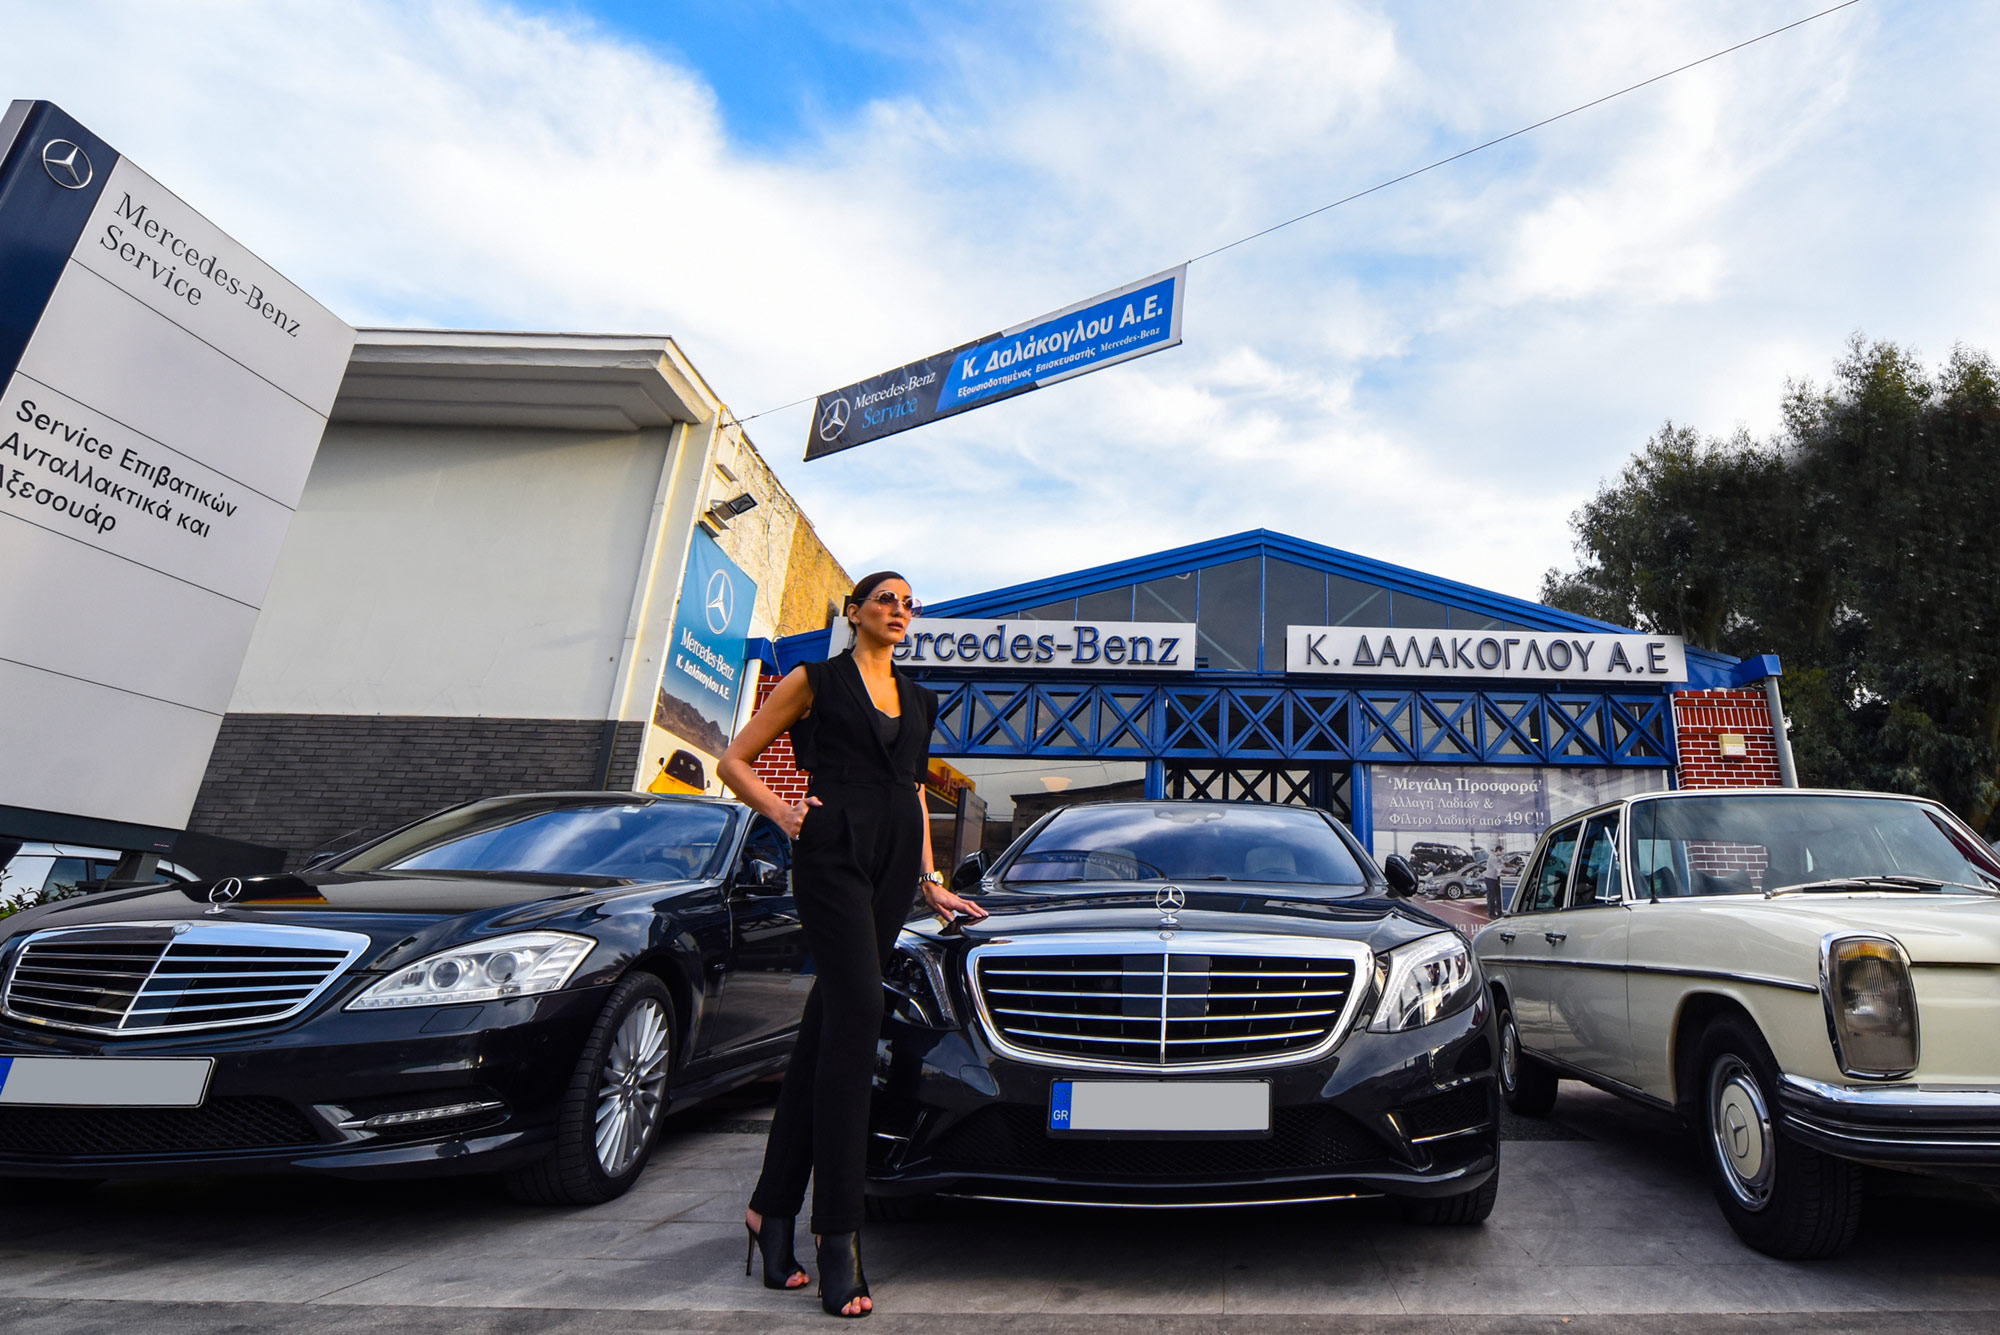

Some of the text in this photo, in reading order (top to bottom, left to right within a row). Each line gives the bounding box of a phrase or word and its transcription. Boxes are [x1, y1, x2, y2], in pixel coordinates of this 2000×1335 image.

[99, 224, 202, 306] Service
[113, 191, 301, 338] Mercedes-Benz
[961, 294, 1164, 380] Κ. Δαλάκογλου Α.Ε.
[957, 326, 1161, 397] Εξουσιοδοτημένος Επισκευαστής Mercedes-Benz
[854, 369, 937, 411] Mercedes-Benz
[861, 395, 919, 430] Service
[15, 399, 239, 519] Service Επιβατικών
[0, 431, 211, 538] Ανταλλακτικά και
[680, 626, 735, 681] Mercedes-Benz
[891, 623, 1181, 665] ercedes-Benz
[1305, 633, 1341, 667] Κ.
[1352, 634, 1596, 672] ΔΑΛΑΚΟΓΛΟΥ
[1389, 797, 1494, 810] Αλλαγή Λαδιών &
[1389, 813, 1432, 827] Φίλτρο
[1435, 814, 1477, 826] Λαδιού
[1479, 815, 1502, 827] από
[1053, 1109, 1069, 1121] GR
